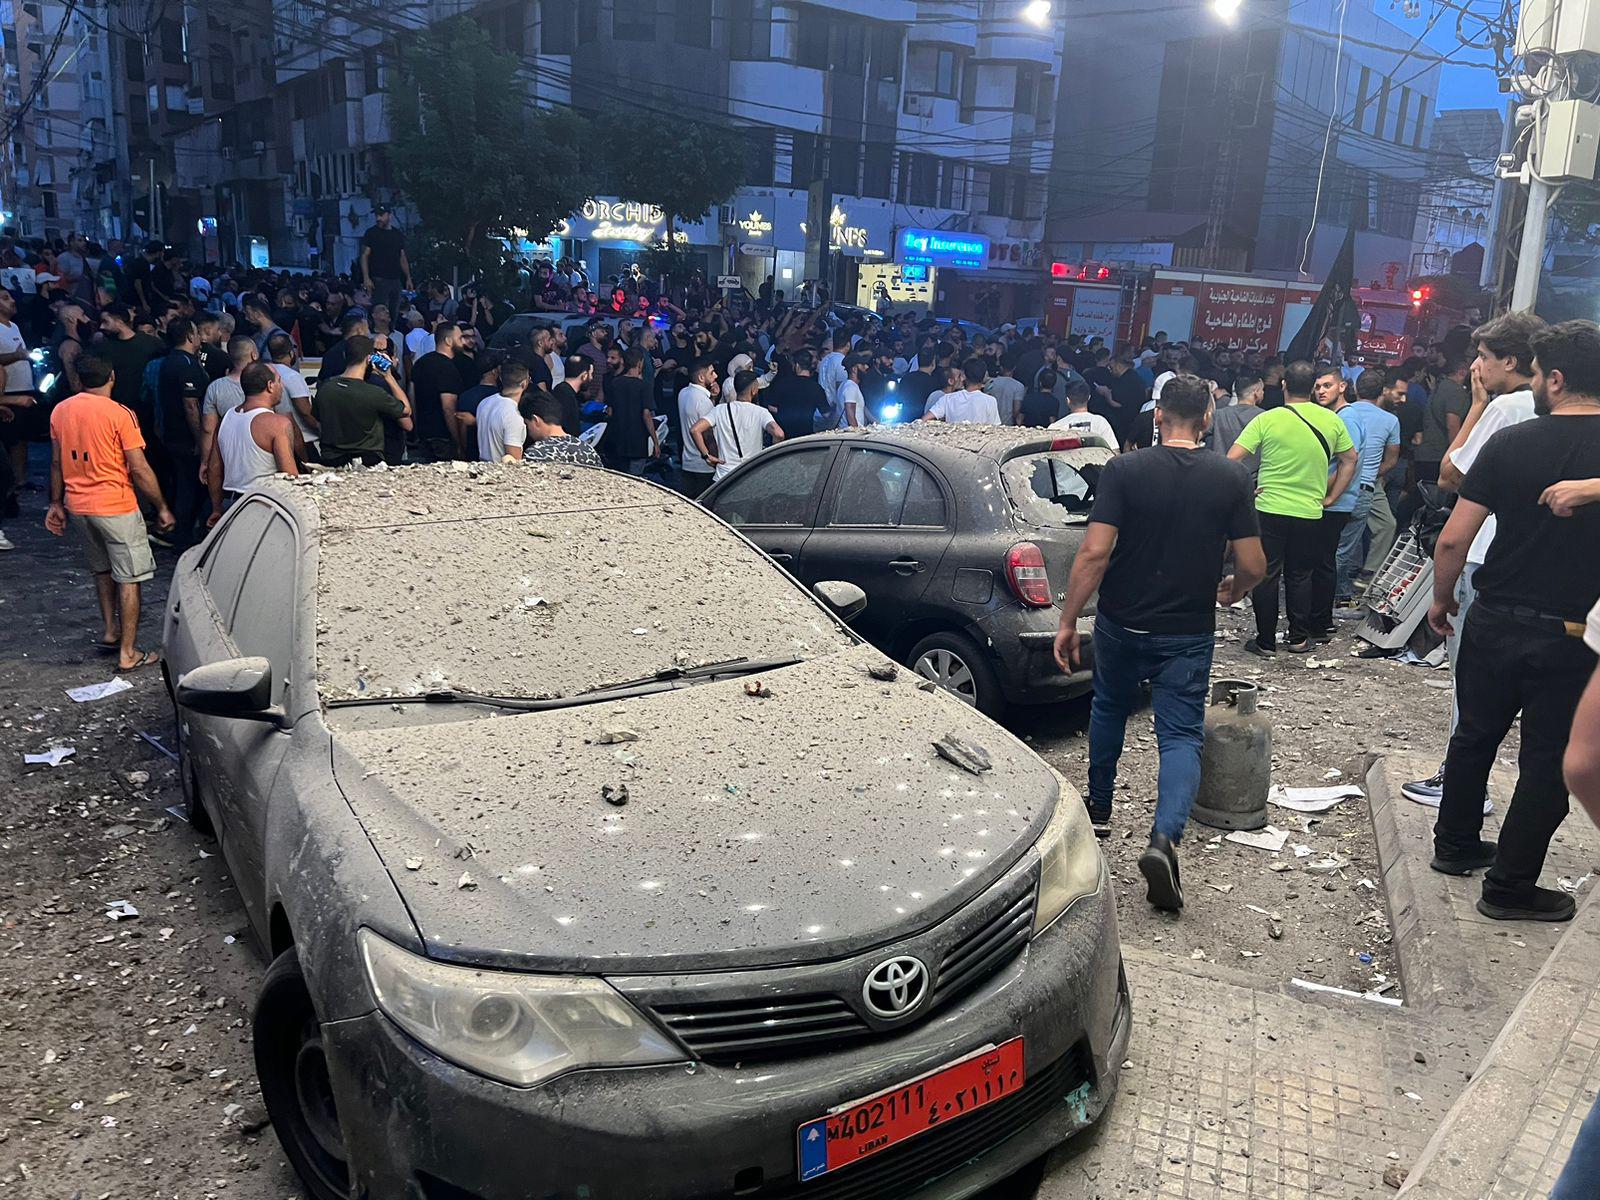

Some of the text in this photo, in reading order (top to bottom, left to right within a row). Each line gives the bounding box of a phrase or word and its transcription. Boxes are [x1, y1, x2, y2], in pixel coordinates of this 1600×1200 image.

[583, 199, 664, 224] ORCHID
[1209, 288, 1230, 305] الجنوبية
[1230, 289, 1250, 304] الضاحية
[1206, 310, 1237, 330] الضاحية
[1256, 314, 1272, 334] فوج
[1243, 338, 1268, 353] مركز
[858, 1135, 889, 1154] LIBAN
